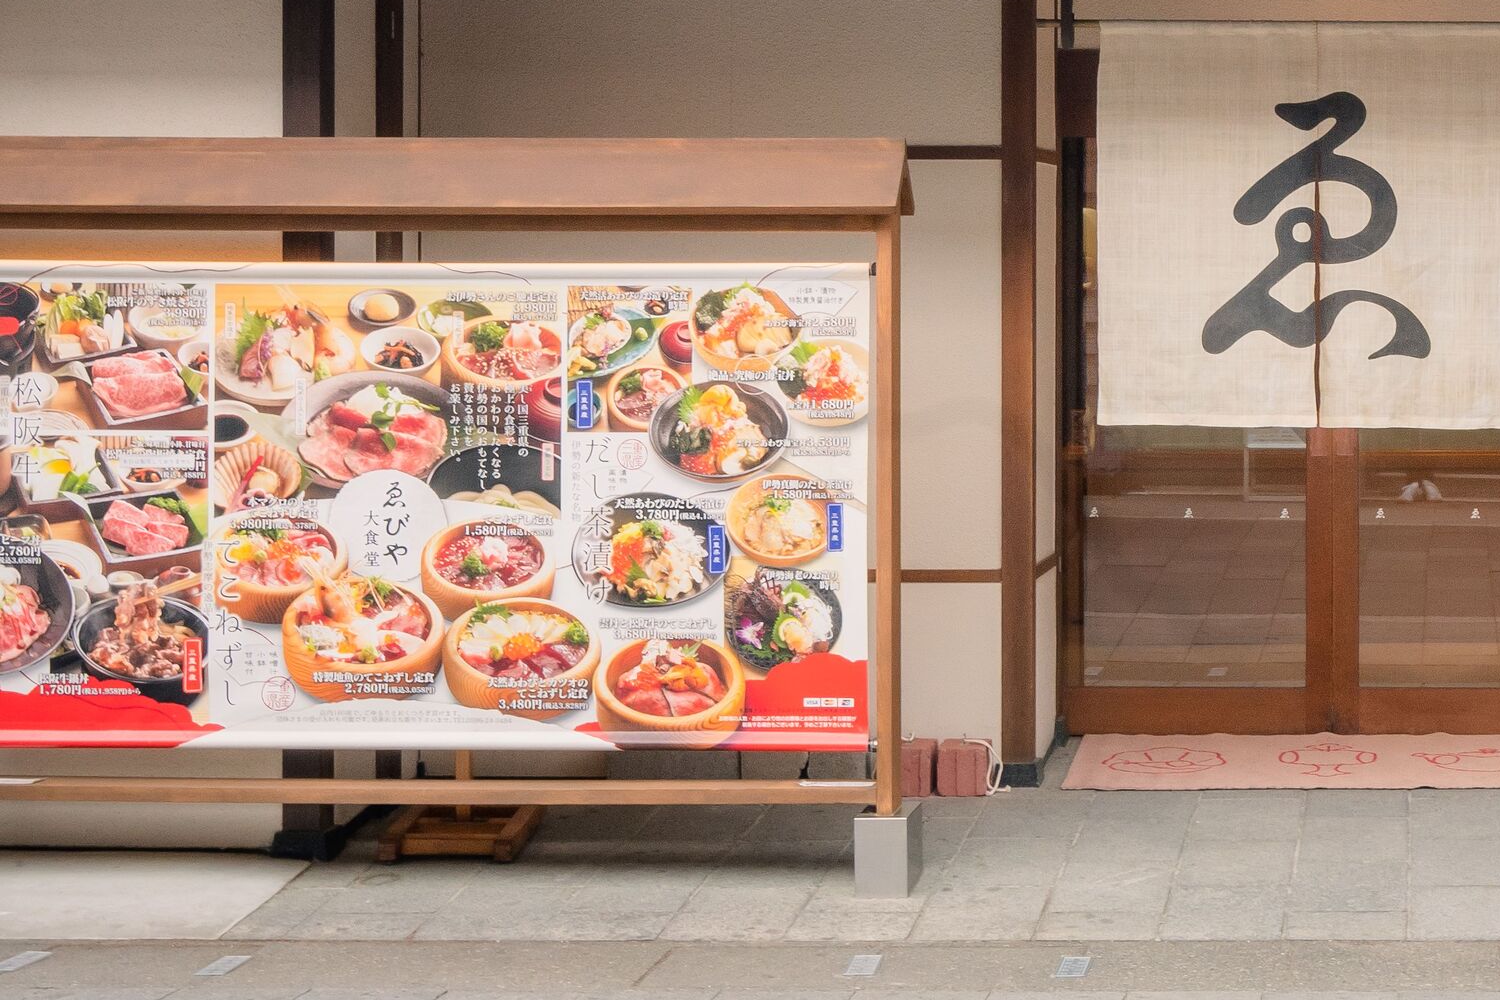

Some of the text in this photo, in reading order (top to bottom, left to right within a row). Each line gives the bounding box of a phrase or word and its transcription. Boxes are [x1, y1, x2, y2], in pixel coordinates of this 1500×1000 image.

[1202, 91, 1431, 360] ゑ
[12, 377, 42, 484] 松阪牛
[450, 383, 461, 462] お楽しみ下さい。
[477, 383, 487, 491] 伊勢の国のおもてなし
[363, 510, 380, 568] 大食堂
[383, 482, 411, 566] ゑびや
[583, 437, 614, 605] だし茶漬け
[216, 541, 243, 706] てこねずし
[313, 673, 434, 683] 特製地魚のてこねずし定食
[487, 678, 588, 688] 天然あわびとカツオの
[516, 689, 588, 699] てこねずし定食
